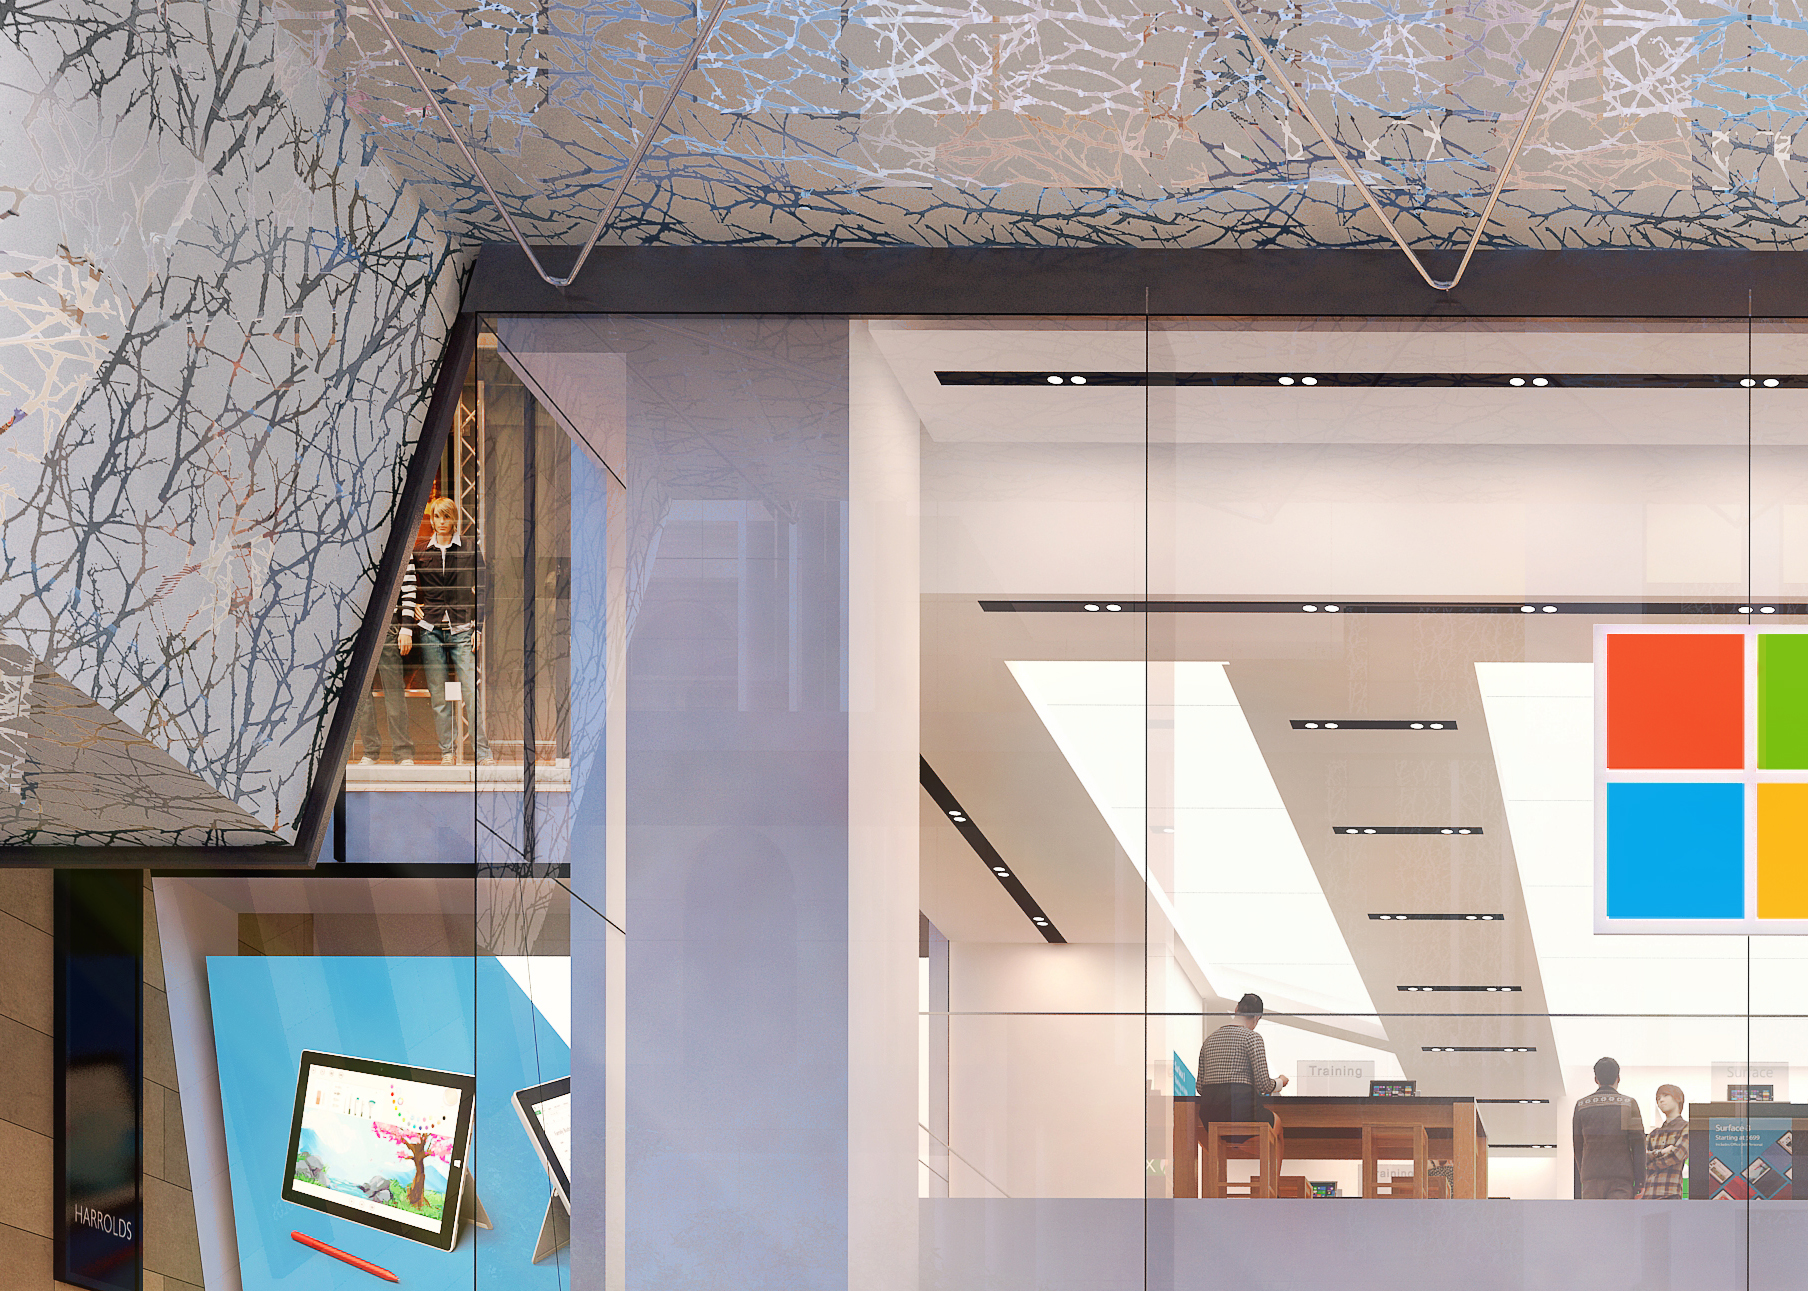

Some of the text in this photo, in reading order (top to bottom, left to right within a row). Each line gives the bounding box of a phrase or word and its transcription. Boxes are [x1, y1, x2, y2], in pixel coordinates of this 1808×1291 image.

[1309, 1065, 1363, 1078] Training
[1715, 1123, 1745, 1132] Surface
[1715, 1134, 1738, 1142] Starting
[75, 1203, 132, 1240] HARROLDS
